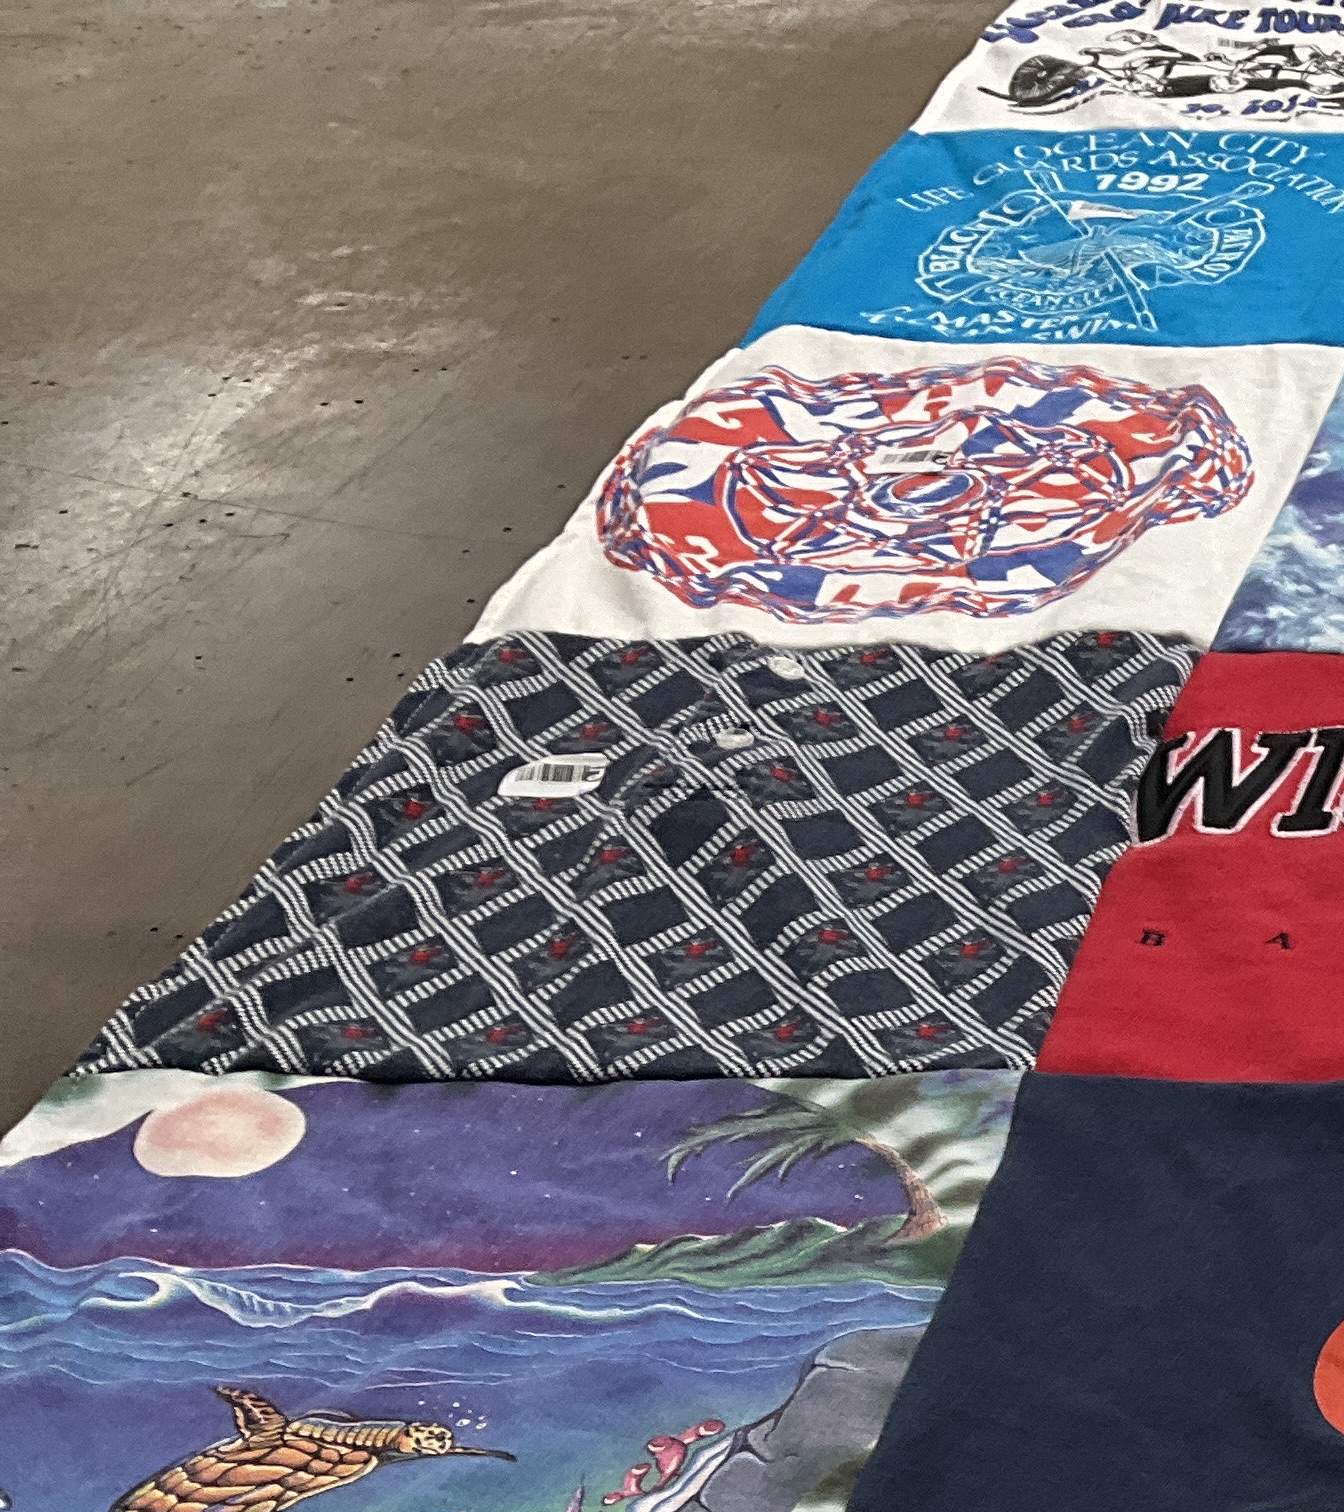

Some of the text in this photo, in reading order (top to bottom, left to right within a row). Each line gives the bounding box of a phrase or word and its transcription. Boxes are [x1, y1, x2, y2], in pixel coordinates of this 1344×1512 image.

[1014, 131, 1326, 164] OCEAN CITY
[1094, 170, 1210, 193] 1992
[895, 185, 975, 213] LIFE
